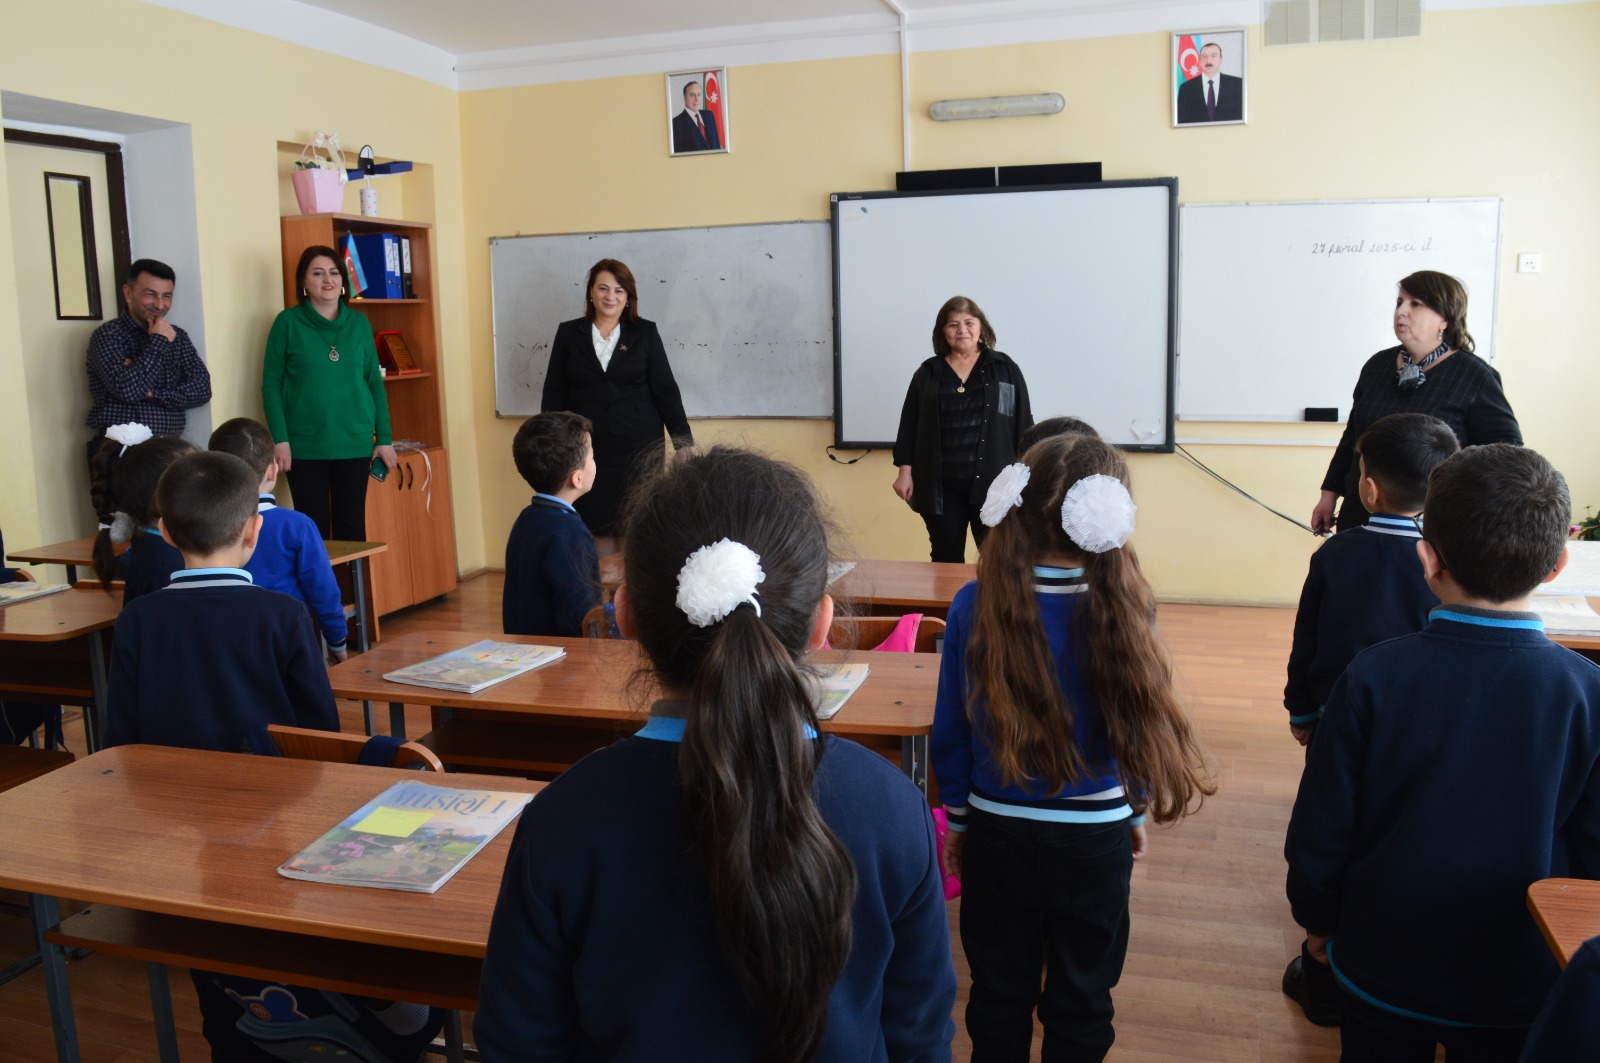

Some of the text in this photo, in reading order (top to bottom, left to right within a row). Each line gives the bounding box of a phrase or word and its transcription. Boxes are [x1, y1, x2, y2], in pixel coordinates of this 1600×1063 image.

[1311, 242, 1326, 255] 27
[1368, 240, 1416, 254] 2025-ci
[489, 799, 508, 814] 1
